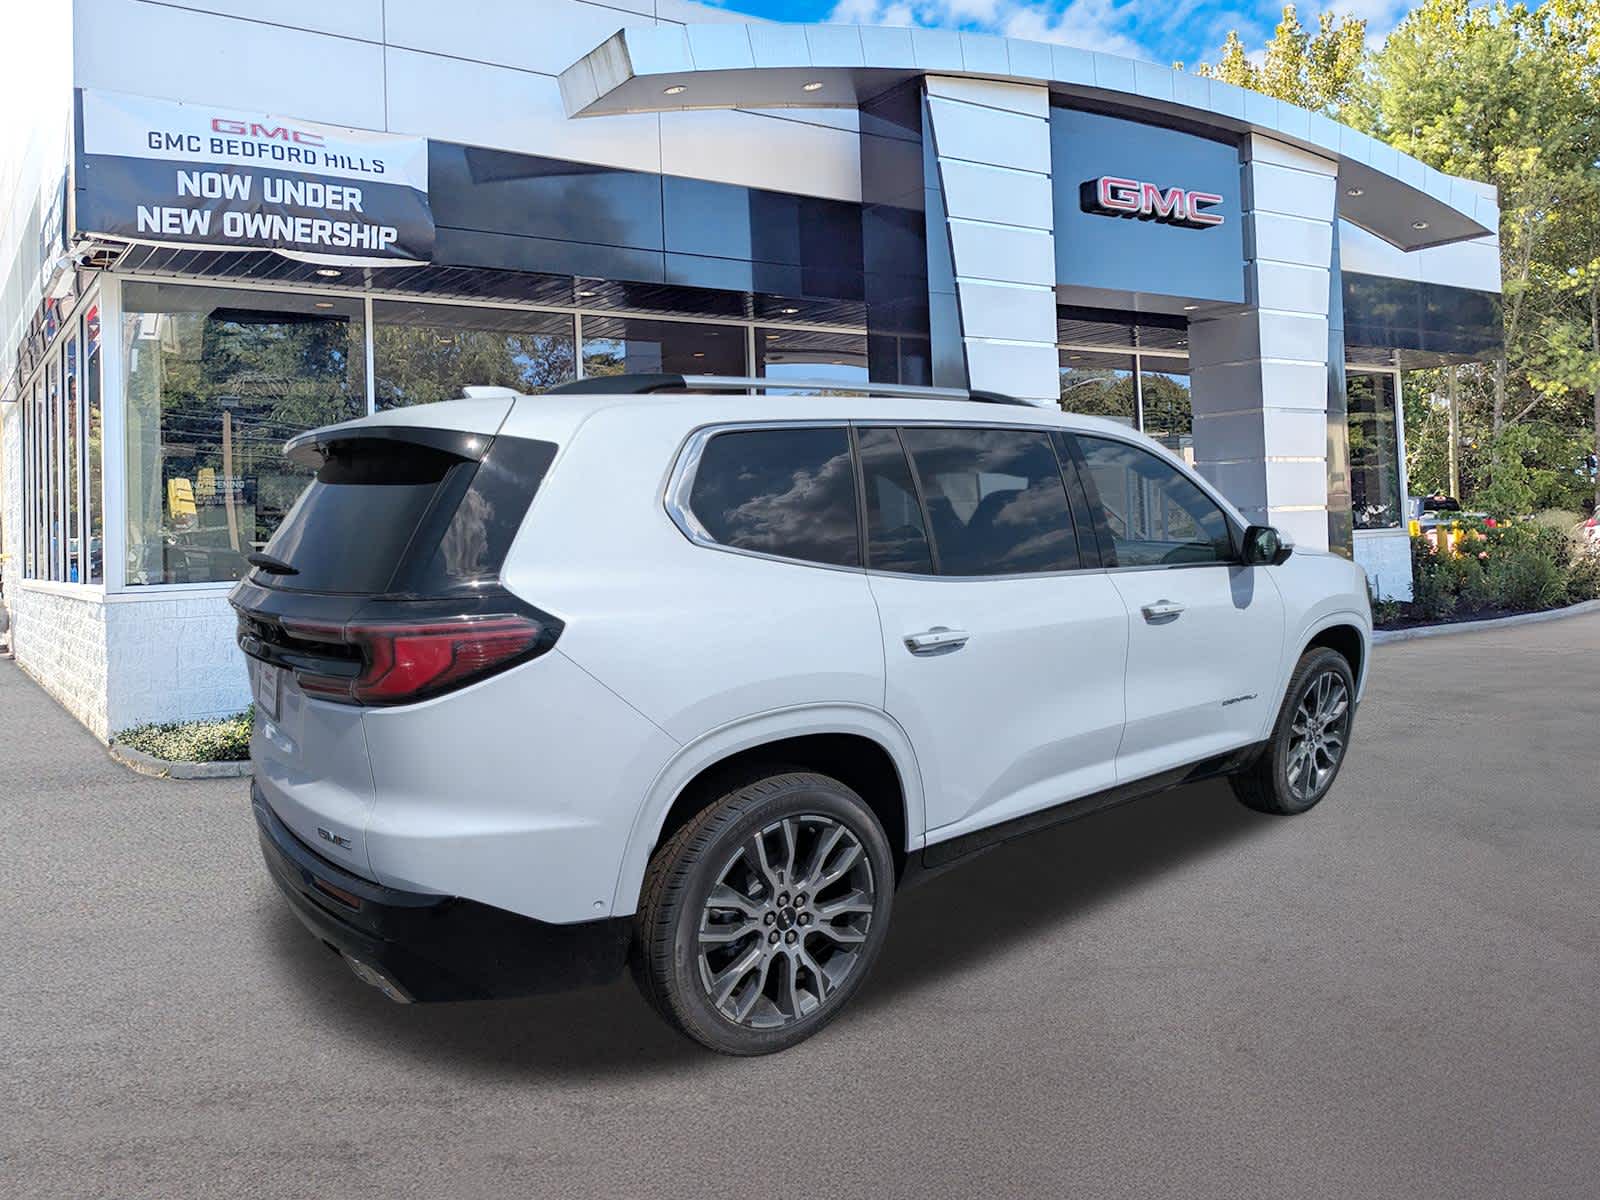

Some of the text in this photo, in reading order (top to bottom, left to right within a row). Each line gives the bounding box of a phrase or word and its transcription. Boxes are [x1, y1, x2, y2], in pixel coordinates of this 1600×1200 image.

[148, 131, 385, 174] GMC BEDFORD HILLS
[211, 118, 325, 147] GMC
[177, 170, 363, 212] NOW UNDER
[1097, 175, 1225, 225] GMC
[137, 205, 398, 250] NEW OWNERSHIP
[317, 827, 353, 850] GMC
